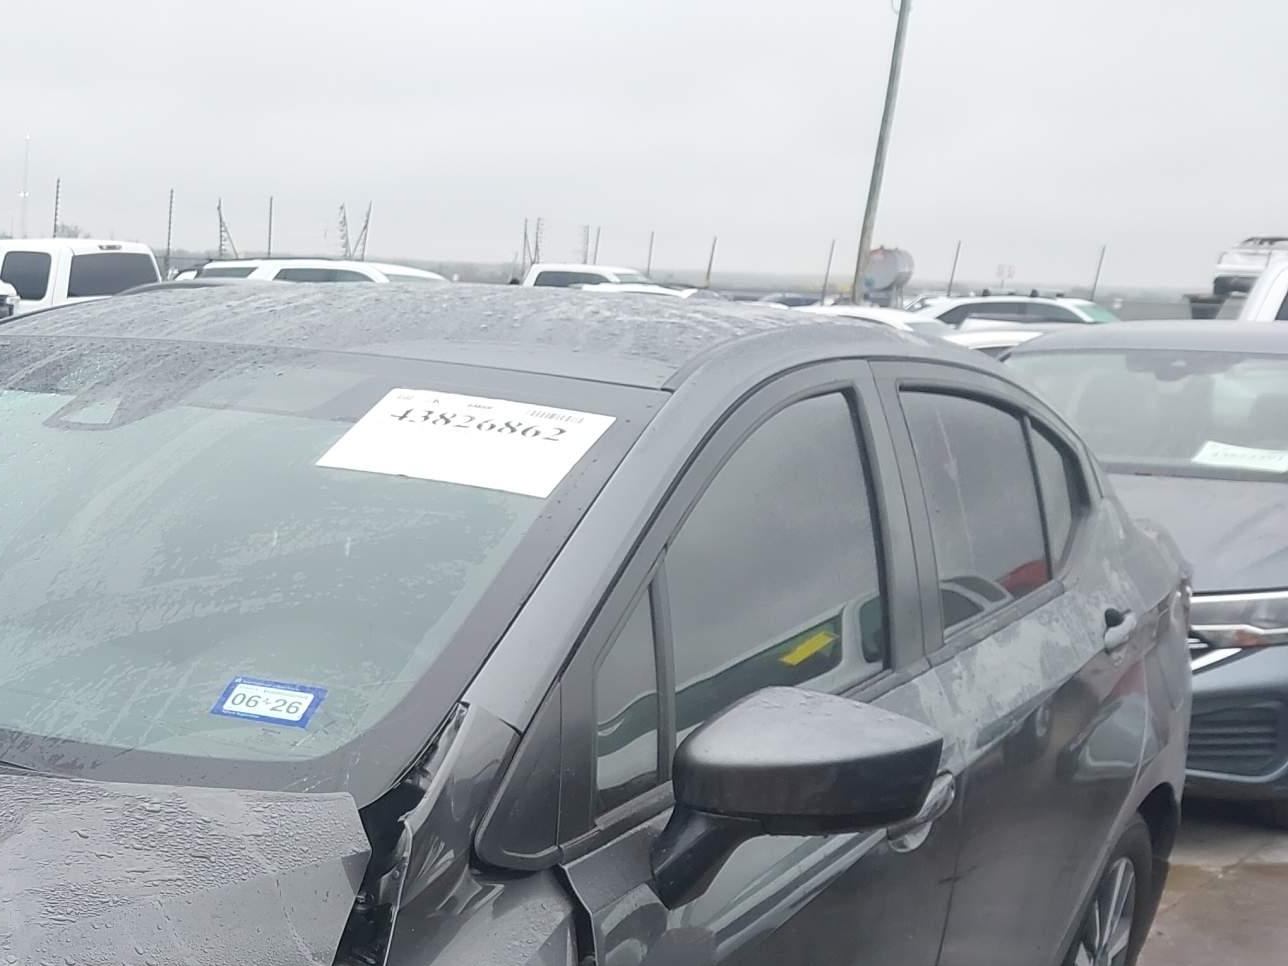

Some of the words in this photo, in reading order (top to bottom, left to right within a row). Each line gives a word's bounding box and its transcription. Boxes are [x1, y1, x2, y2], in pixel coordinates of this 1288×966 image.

[390, 408, 567, 442] 43826862
[231, 692, 261, 708] 06
[269, 698, 303, 714] 26
